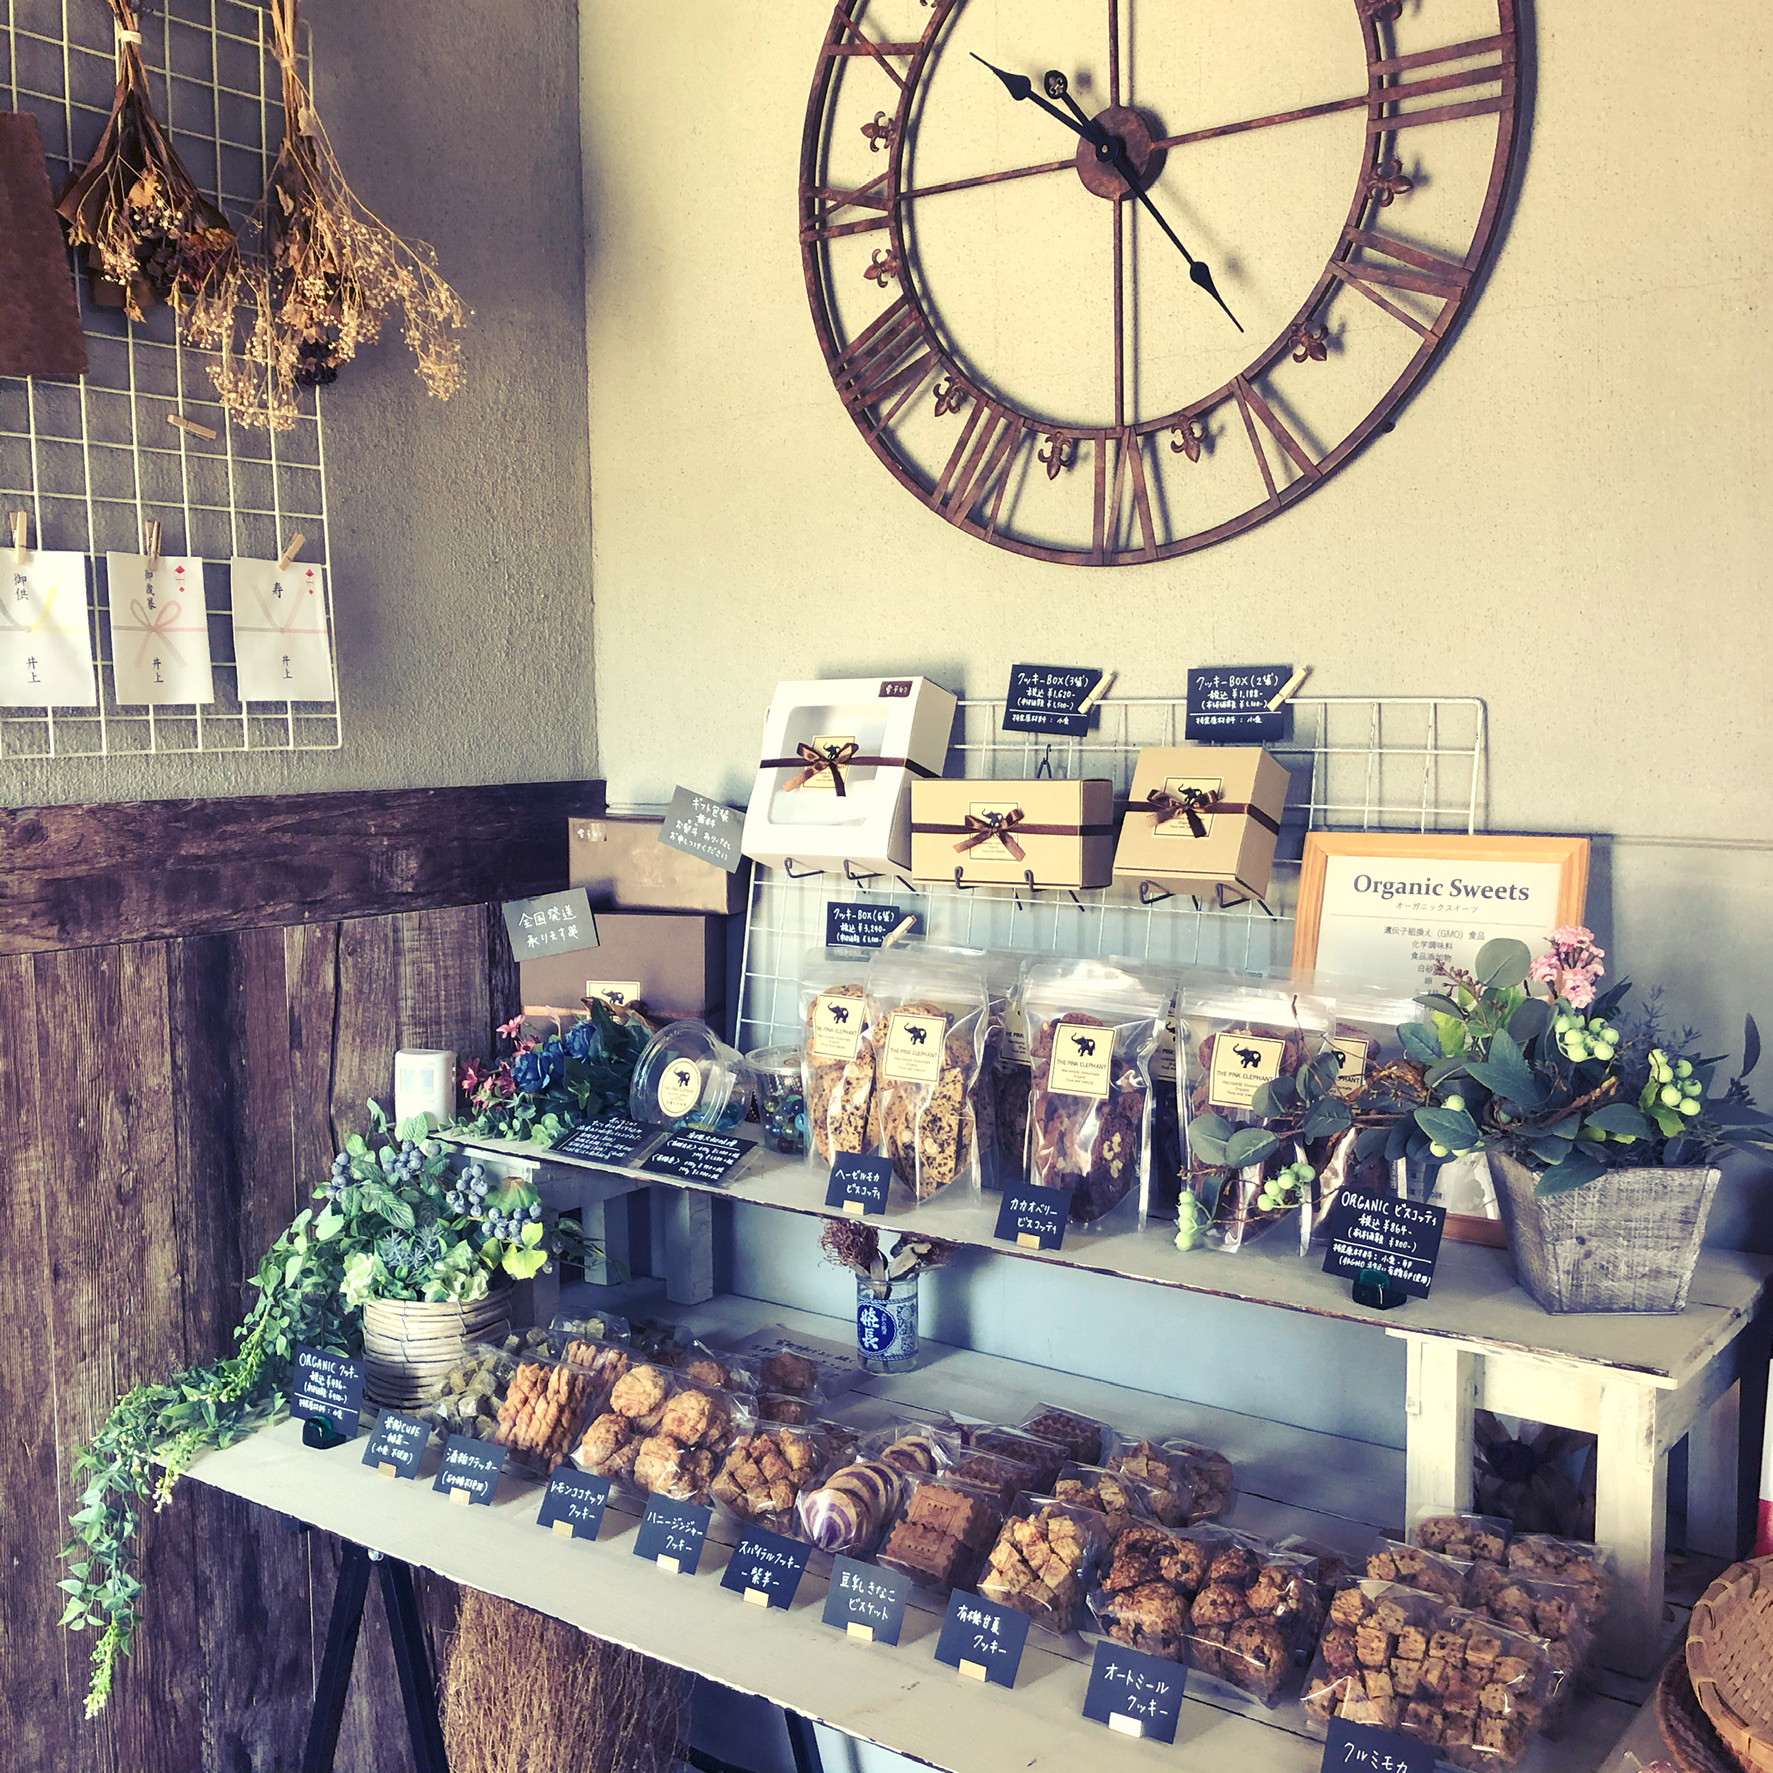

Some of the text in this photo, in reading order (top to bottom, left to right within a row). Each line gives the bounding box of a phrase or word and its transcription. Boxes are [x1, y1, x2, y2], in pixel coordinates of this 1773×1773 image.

[14, 573, 29, 601] 御供
[272, 582, 284, 599] 寿
[26, 656, 41, 684] 井上
[153, 657, 164, 684] 井上
[282, 655, 293, 680] 井上
[1353, 874, 1530, 901] Organic Sweets
[518, 905, 577, 929] 全国発送
[1396, 902, 1479, 914] オーガニックスイーツ
[1411, 941, 1453, 950] 化学調味料
[1228, 1071, 1240, 1079] PINK
[835, 1168, 880, 1183] ヘーゼルモカ
[846, 1183, 881, 1200] ビスコッティ
[1009, 1198, 1058, 1216] カカオベリー
[1341, 1191, 1389, 1215] ORGANIC
[1394, 1202, 1437, 1227] ビスコッティ
[1016, 1216, 1057, 1235] ビスコッティ
[299, 1352, 359, 1380] ORGANIC クッキー
[445, 1447, 498, 1471] 酒粕クラッカー
[550, 1480, 605, 1507] レモンココナッツ
[568, 1503, 596, 1520] クッキー
[646, 1511, 703, 1538] ハニージンジャー
[665, 1534, 693, 1551] クッキー
[738, 1540, 801, 1570] スパイラルクッキー
[839, 1571, 896, 1602] 豆乳きなこ
[848, 1597, 889, 1621] ビスケット
[956, 1604, 1001, 1636] 有機甘夏
[972, 1634, 1008, 1655] クッキー
[1103, 1662, 1170, 1696] オートミール
[1126, 1694, 1169, 1717] クッキー
[1344, 1742, 1408, 1773] クルミモカ
